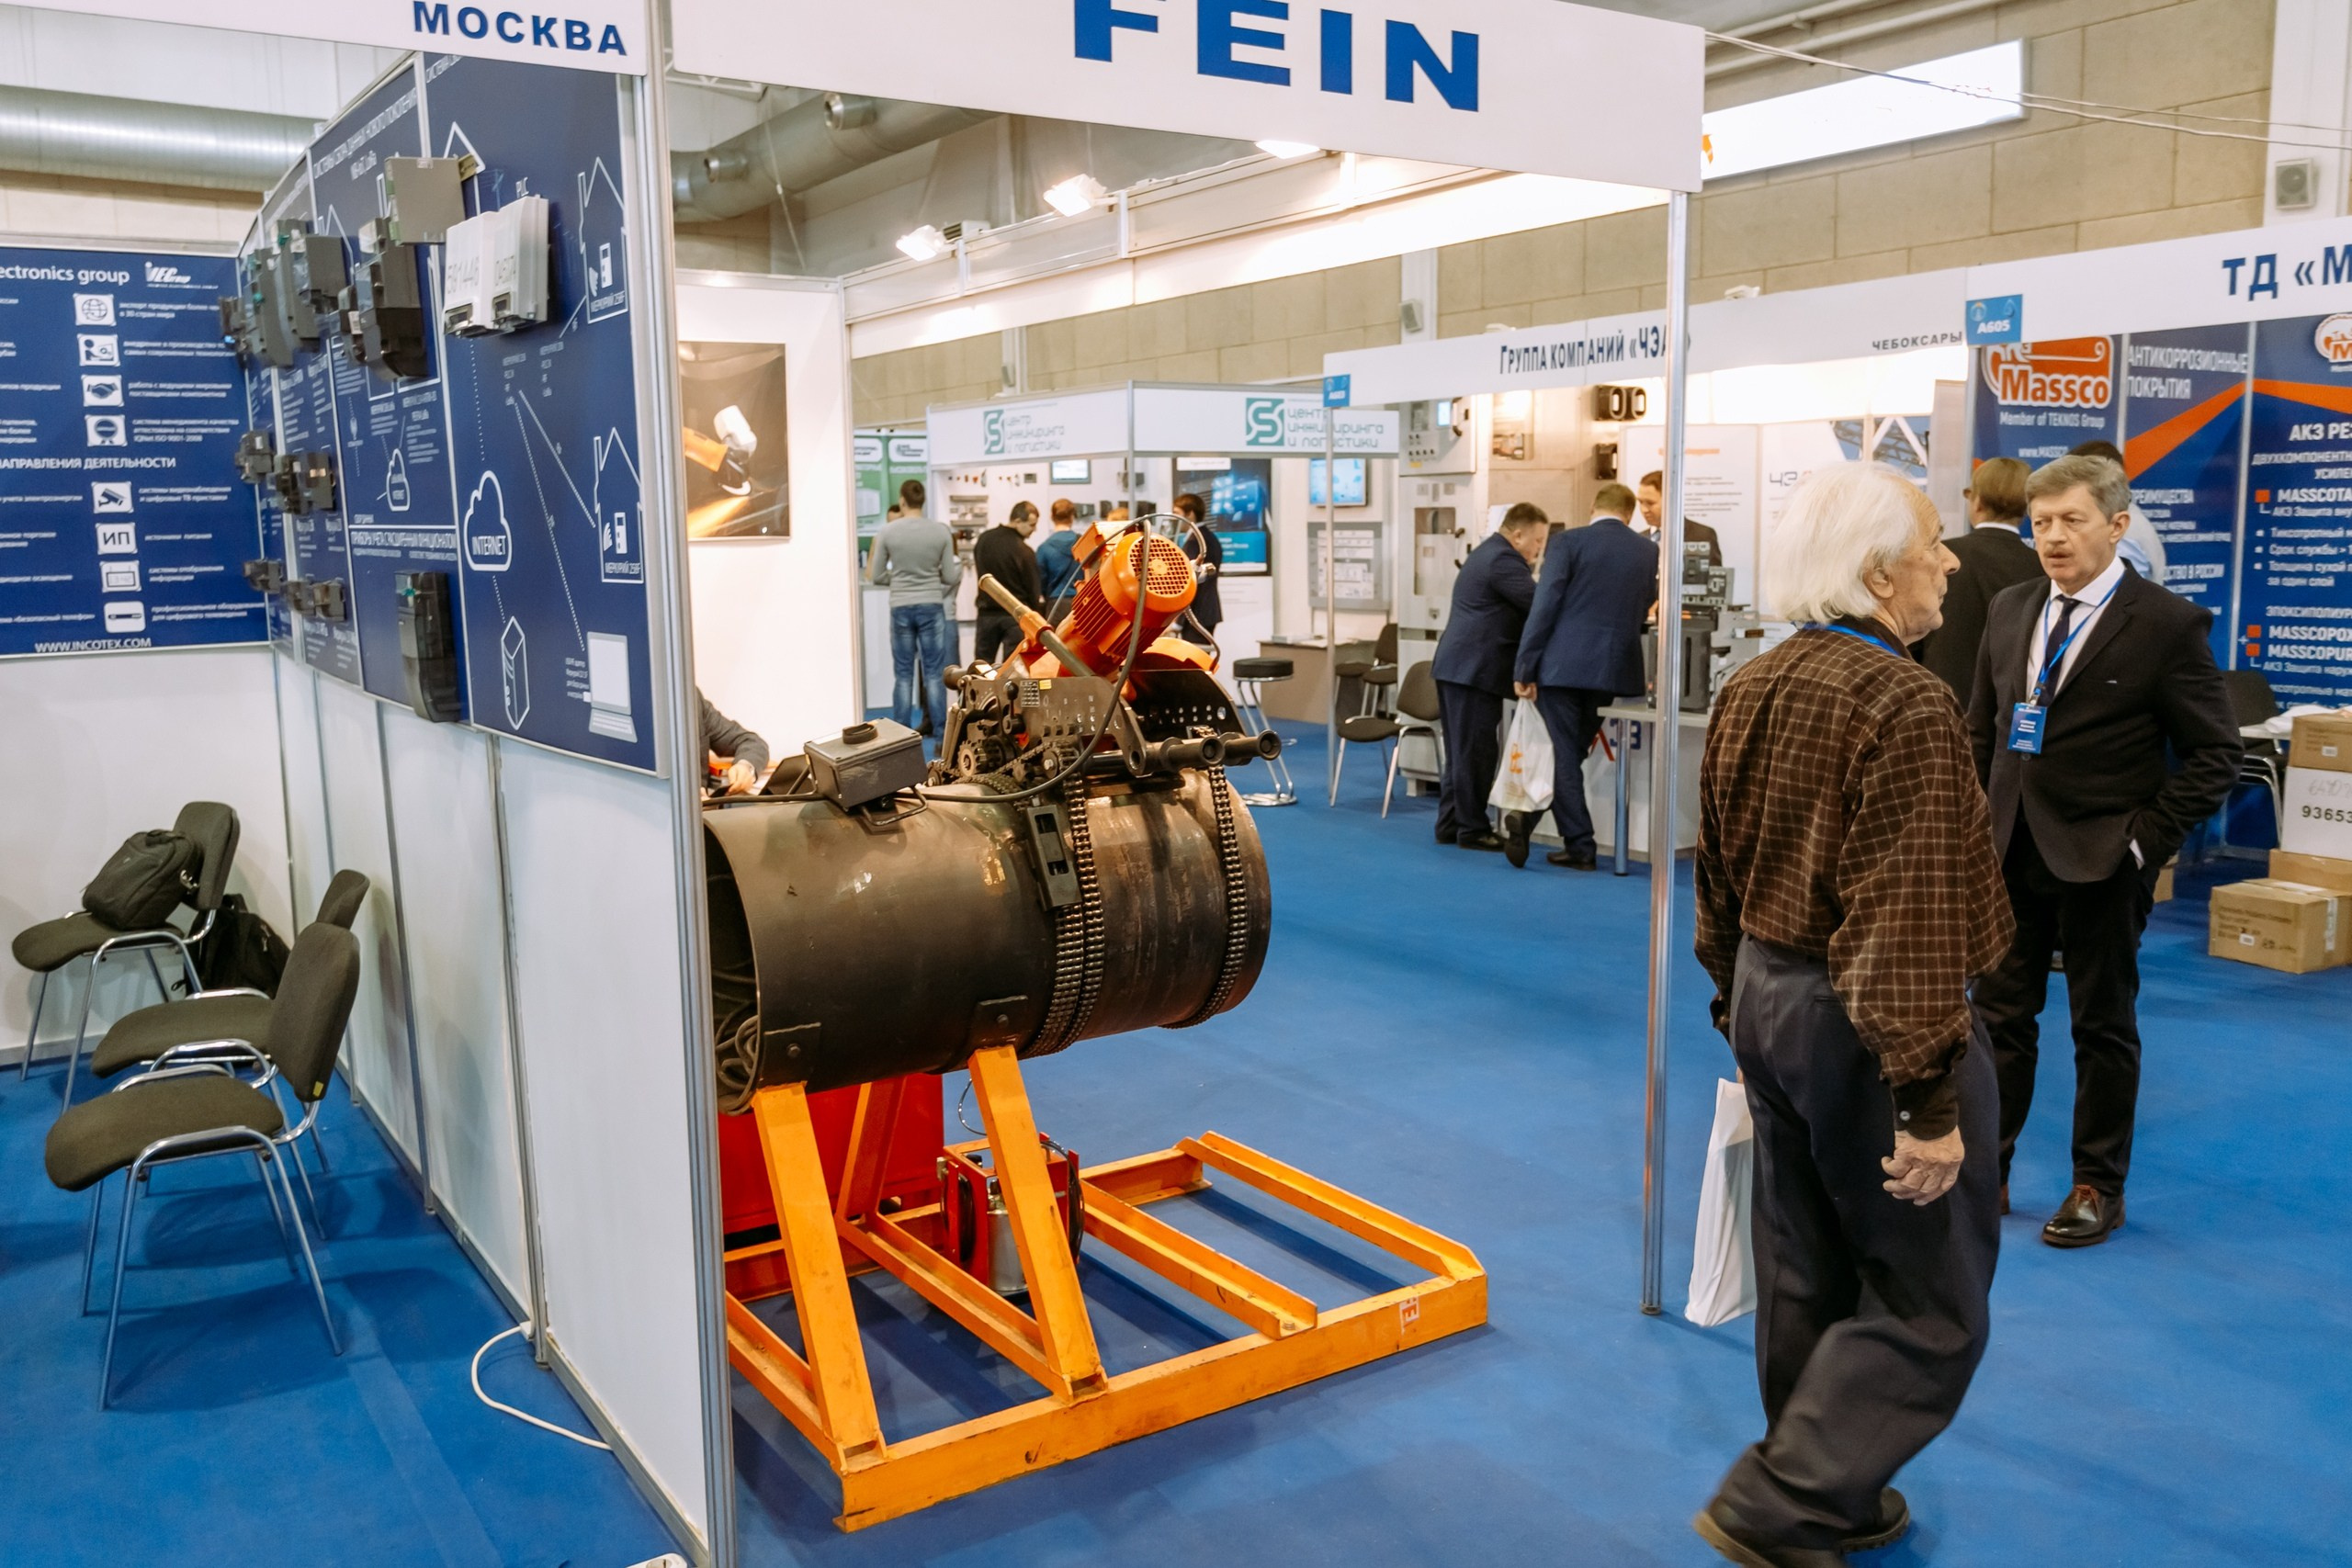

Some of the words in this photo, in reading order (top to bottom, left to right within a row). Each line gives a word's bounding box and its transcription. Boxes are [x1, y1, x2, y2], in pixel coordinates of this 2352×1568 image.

[413, 1, 628, 56] МОСКВА
[1074, 0, 1479, 112] FEIN
[78, 268, 130, 286] group
[2222, 254, 2278, 301] ТД
[1977, 320, 2011, 334] A605
[1872, 332, 1963, 351] ЧЕБОКСАРЫ
[1998, 364, 2110, 407] Massco
[2127, 377, 2192, 400] ПОКРЫТИЯ
[1287, 423, 1384, 436] инжииринга
[1999, 412, 2035, 426] Member
[2037, 411, 2048, 426] of
[2081, 413, 2106, 430] Group
[2289, 423, 2325, 442] АКЗ
[1302, 437, 1378, 448] логстики
[0, 457, 82, 469] АПРАВЛЕНИЯ
[84, 457, 176, 470] ДЕЯТЕЛЬНОСТИ
[103, 531, 130, 546] ИП
[472, 536, 506, 556] INTERNET
[34, 636, 152, 653] WWW.INCOTEX.COM
[2301, 805, 2352, 824] 93653
